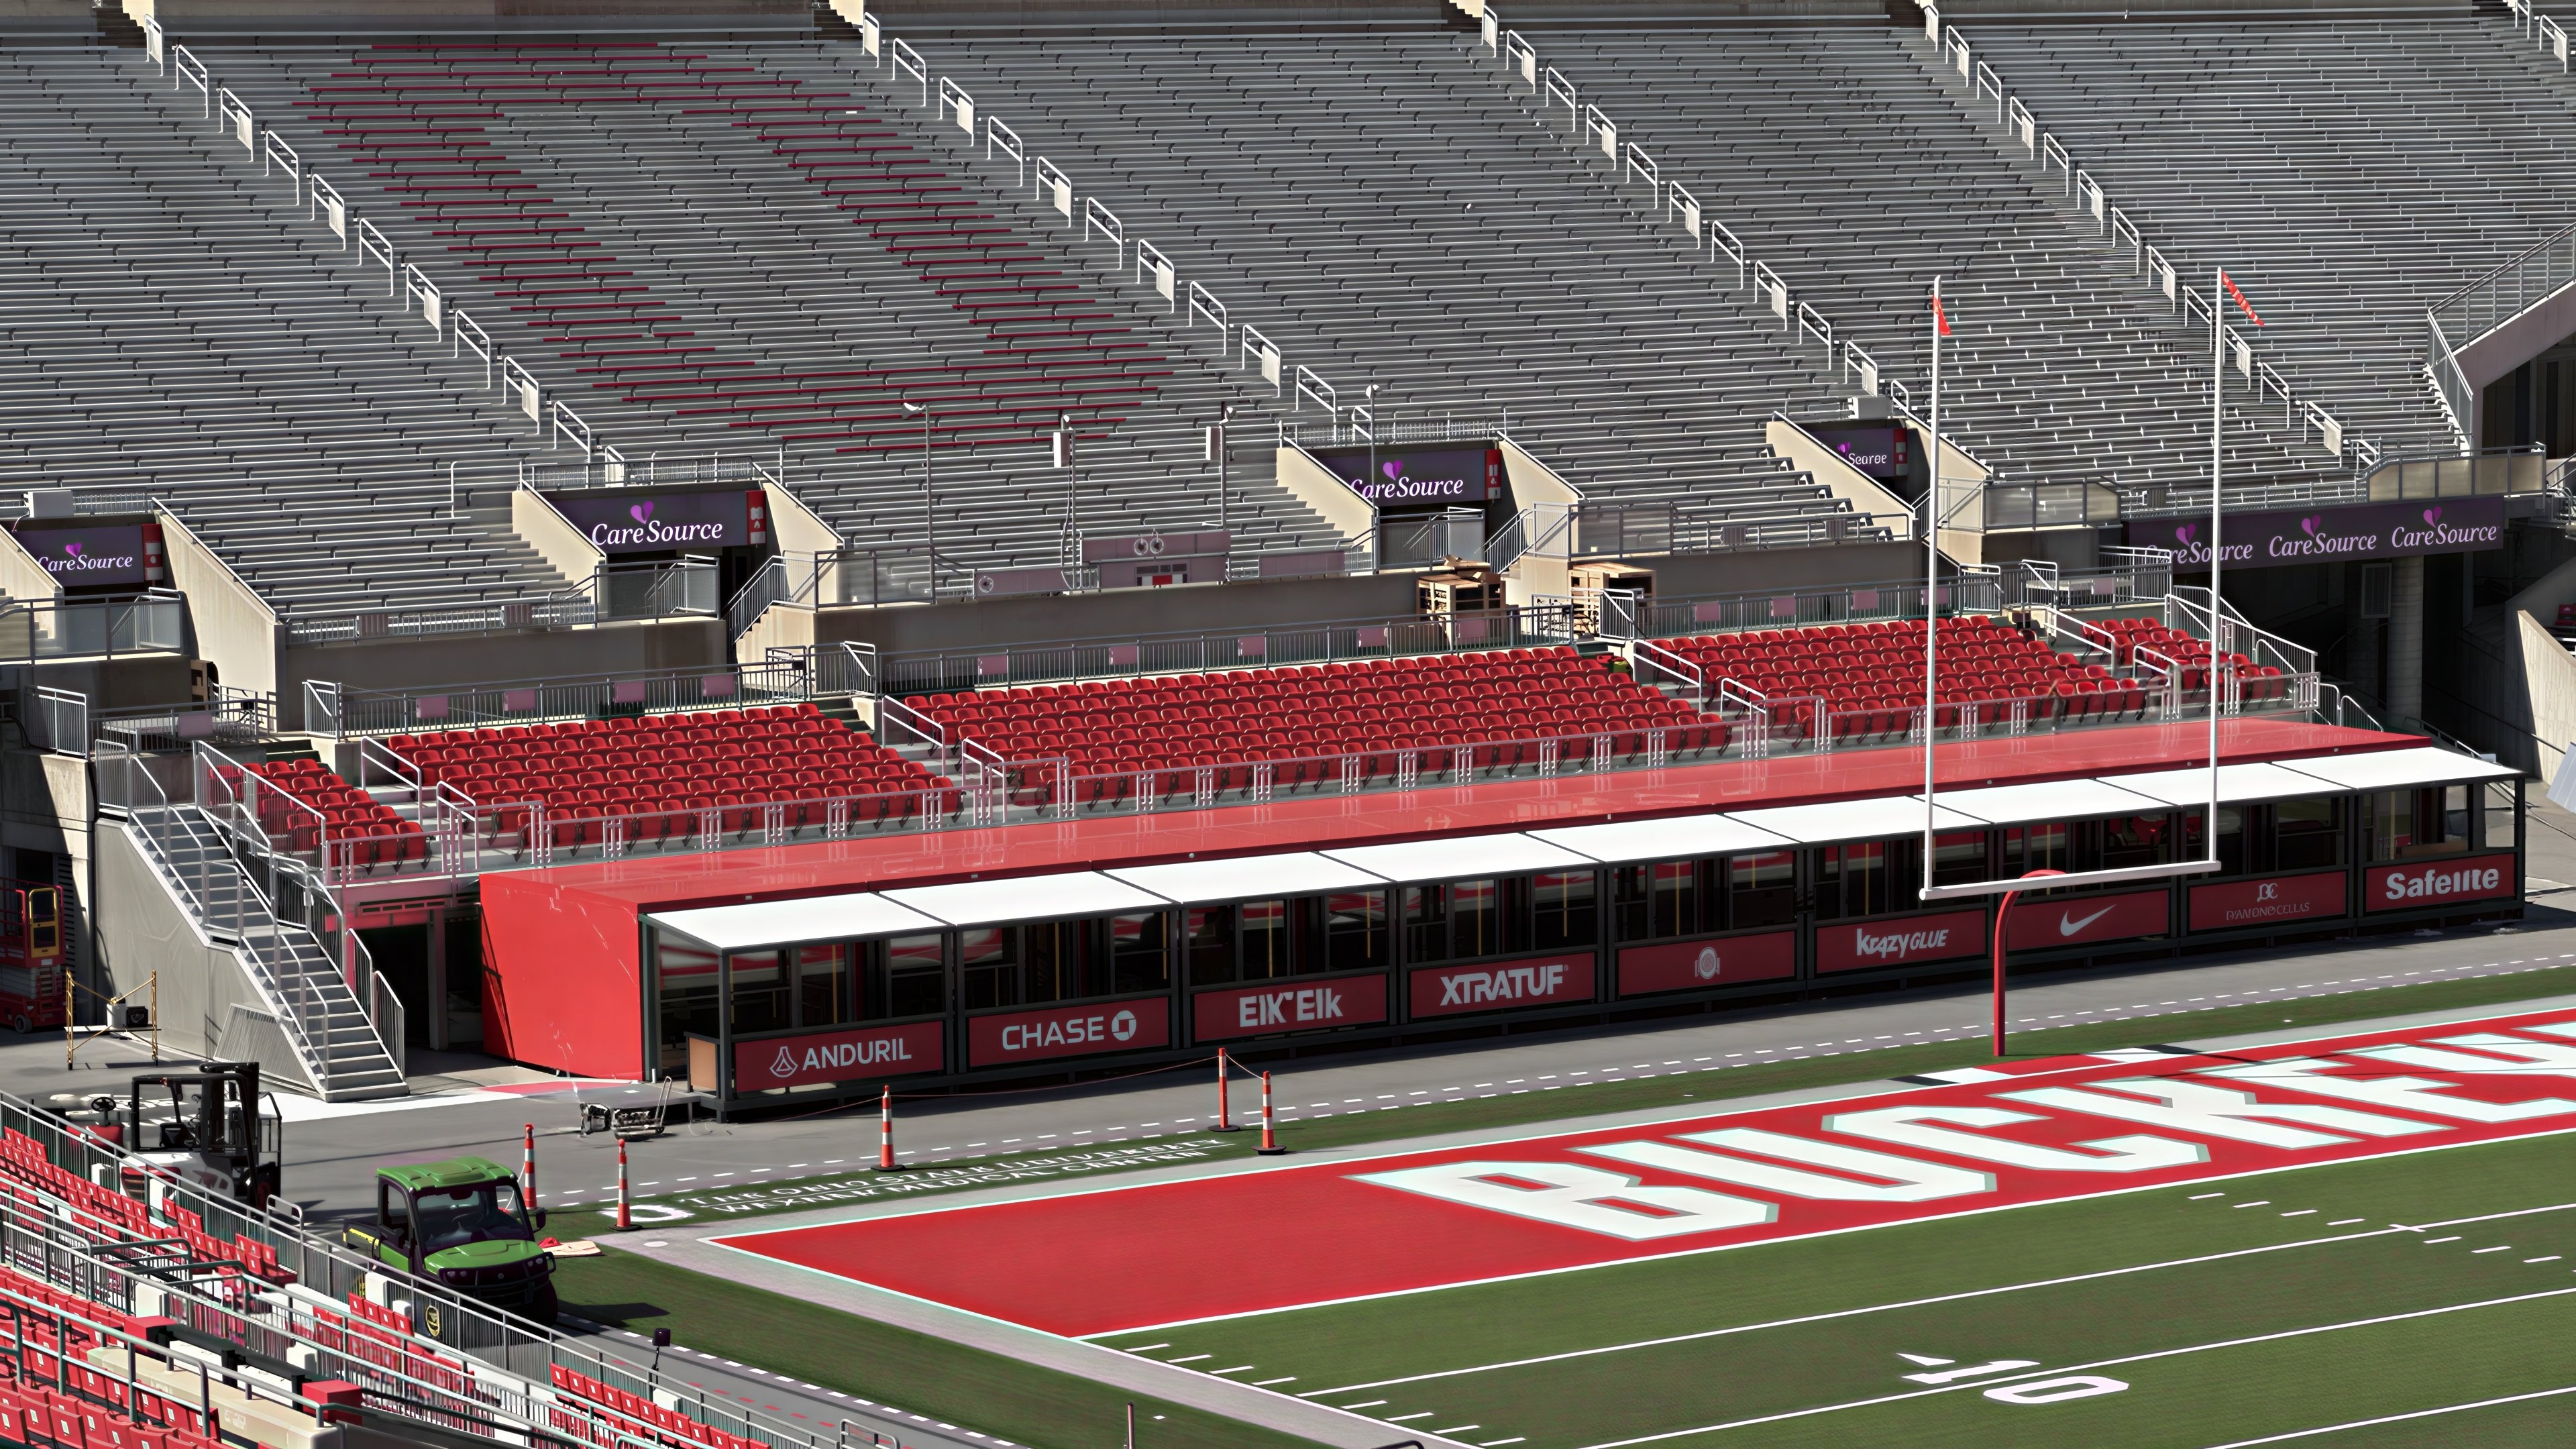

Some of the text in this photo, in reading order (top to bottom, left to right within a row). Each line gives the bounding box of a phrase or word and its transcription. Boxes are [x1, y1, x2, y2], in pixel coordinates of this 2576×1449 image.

[591, 520, 723, 545] CareSource
[2269, 533, 2377, 557] CareSource
[2392, 523, 2498, 548] CareSource
[1440, 964, 1564, 1006] XTRATUF
[1002, 1016, 1105, 1051] CHASE
[802, 1038, 912, 1071] ANDURIL
